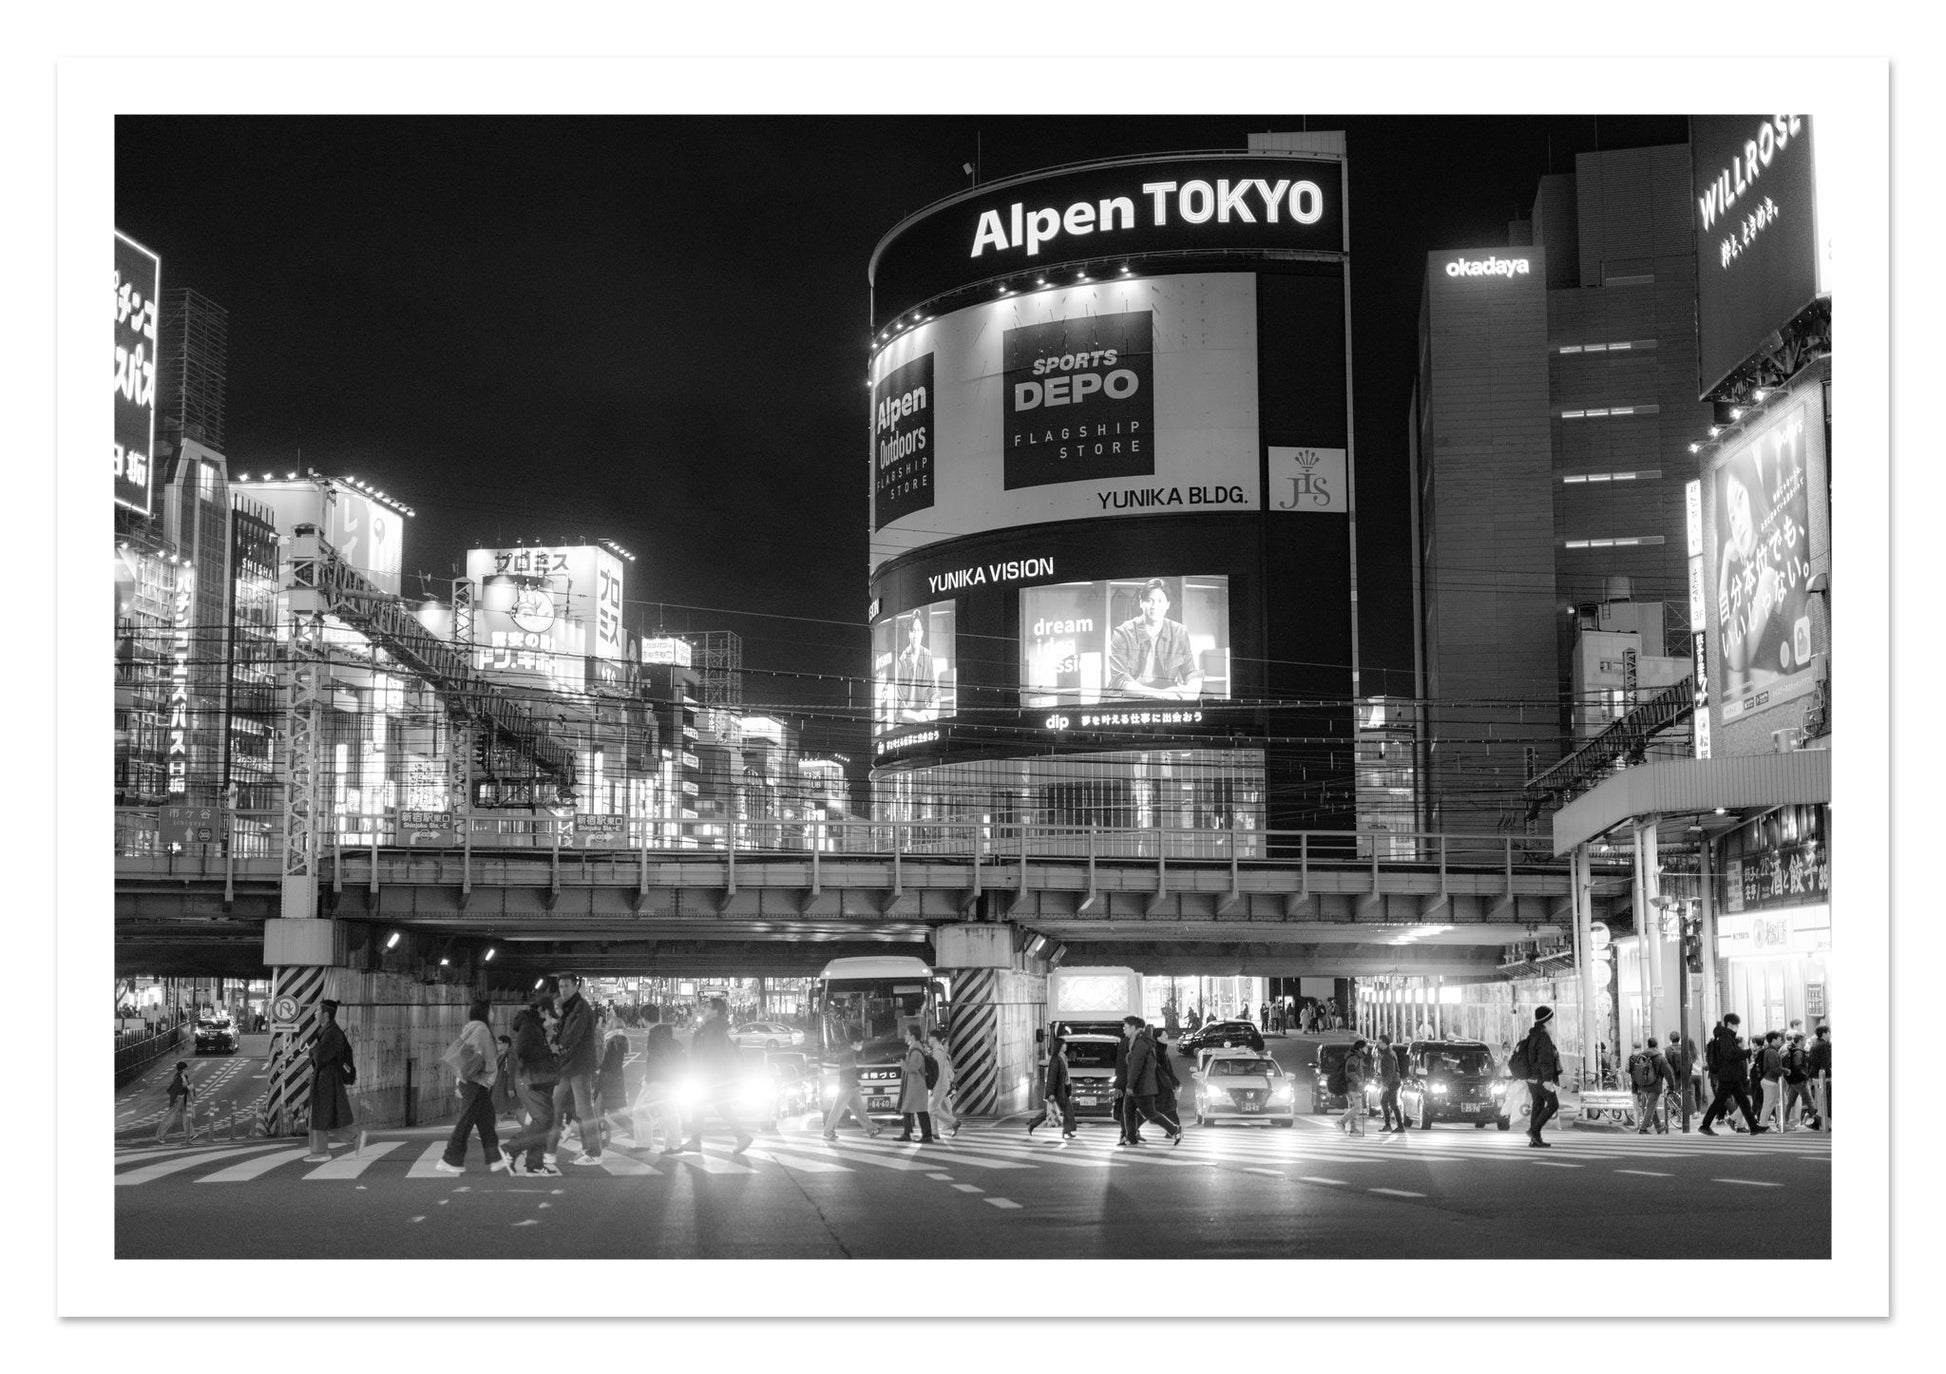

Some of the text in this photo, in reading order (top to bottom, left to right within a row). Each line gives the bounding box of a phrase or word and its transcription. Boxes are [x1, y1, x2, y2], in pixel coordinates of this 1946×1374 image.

[971, 178, 1324, 258] Alpen TOKYO
[1446, 255, 1530, 278] okadaya
[1033, 349, 1118, 376] SPORTS
[1015, 369, 1139, 412] DEPO
[877, 386, 927, 436] Alpen
[1015, 421, 1140, 447] FLAGSHIP
[880, 426, 927, 471] Outdoors
[1060, 440, 1140, 459] STORE
[877, 457, 928, 493] FLAGSHIP
[890, 475, 928, 500] STORE
[1098, 486, 1248, 510] YUNIKA BLDG.
[242, 558, 273, 580] SHISHA
[495, 552, 569, 573] プロミス
[928, 557, 1054, 594] YUNIKA VISION
[1033, 617, 1094, 637] dream
[1045, 714, 1070, 730] dip
